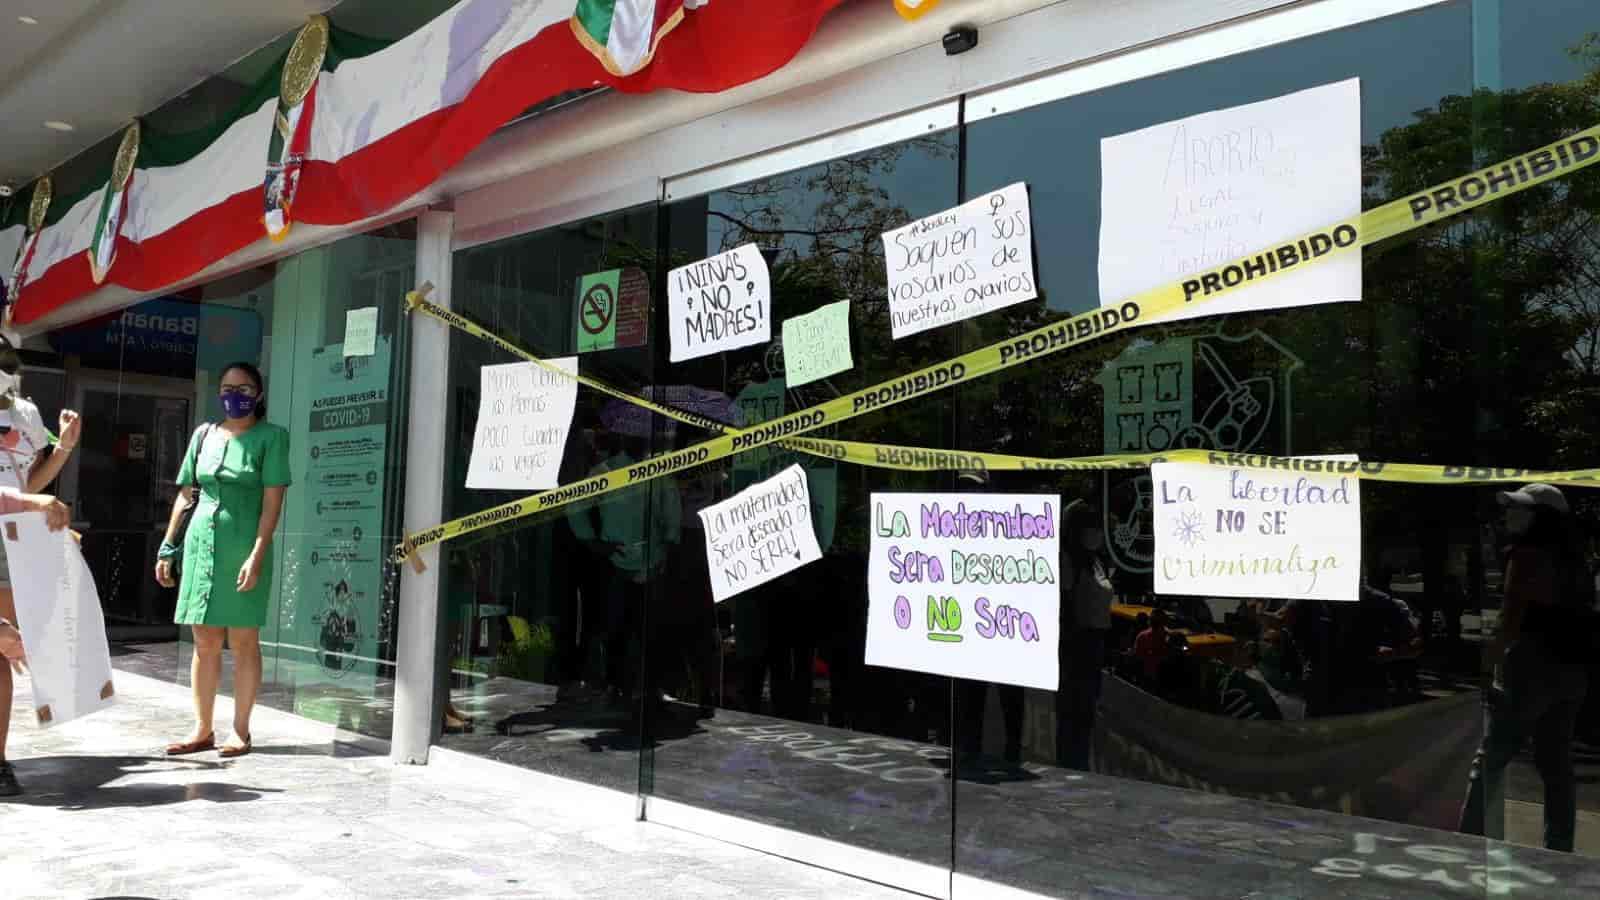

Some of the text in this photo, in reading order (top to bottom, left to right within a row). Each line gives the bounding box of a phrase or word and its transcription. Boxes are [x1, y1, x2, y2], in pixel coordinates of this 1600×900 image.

[890, 244, 1021, 303] rosarios de
[701, 284, 731, 315] NO
[892, 271, 1032, 329] nuestros ovarios
[458, 503, 523, 531] PROHIBIDO
[538, 477, 609, 508] PROHIBIDO
[628, 447, 709, 481] PROHIBIDO
[731, 409, 826, 451] PROHIBIDO
[852, 362, 967, 413] PROHIBIDO
[1000, 301, 1141, 364] PROHIBIDO
[1182, 223, 1358, 301] PROHIBIDO
[1408, 134, 1600, 221] PROHIBID
[685, 299, 763, 347] MADRES!
[1161, 480, 1195, 504] La
[876, 501, 1055, 540] La Maternidad
[1216, 509, 1287, 535] NO SE
[724, 560, 747, 588] NO
[951, 548, 1056, 585] Deseada
[926, 594, 963, 633] NO
